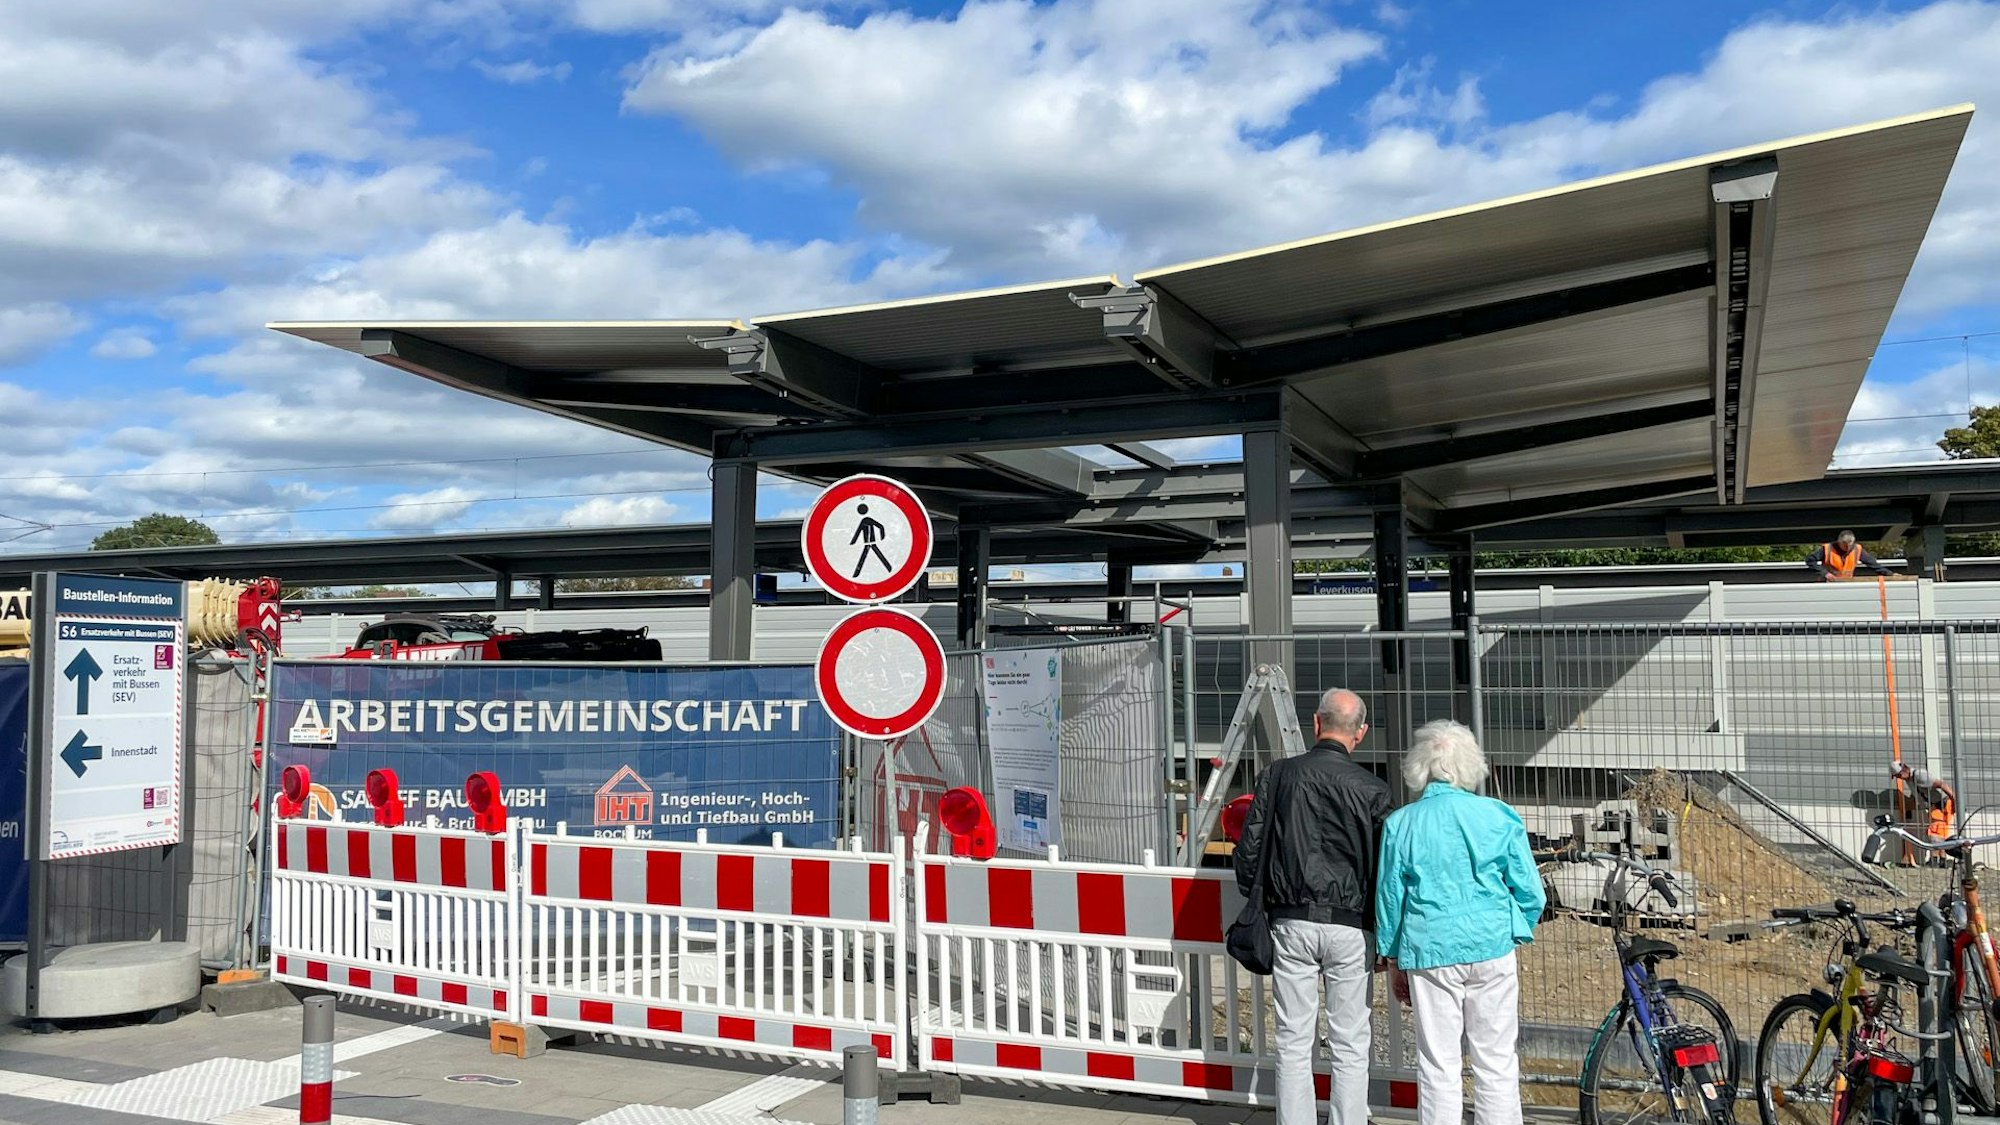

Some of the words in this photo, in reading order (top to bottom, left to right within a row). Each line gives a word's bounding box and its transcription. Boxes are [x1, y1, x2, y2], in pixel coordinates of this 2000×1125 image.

[63, 588, 173, 605] Baustellen-Information
[1313, 584, 1374, 595] Leverkusen
[61, 625, 77, 637] S6
[81, 628, 123, 637] Ersatzverkehr
[124, 629, 135, 637] mit
[136, 630, 157, 638] Bussen
[113, 654, 143, 665] Ersatz-
[113, 668, 146, 677] verkehr
[112, 680, 127, 689] mit
[129, 679, 160, 689] Bussen
[112, 692, 137, 703] (SEV)
[294, 699, 808, 733] ARBEITSGEMEINSCHAFT
[111, 746, 158, 757] Innenstadt
[341, 789, 420, 809] SAEF
[499, 788, 546, 807] MBH
[660, 793, 756, 808] Ingenieur-,
[761, 792, 810, 806] Hoch-
[600, 797, 649, 820] IHT
[660, 812, 692, 825] und
[696, 810, 760, 825] Tiefbau
[764, 810, 814, 824] GmbH
[0, 821, 19, 838] en
